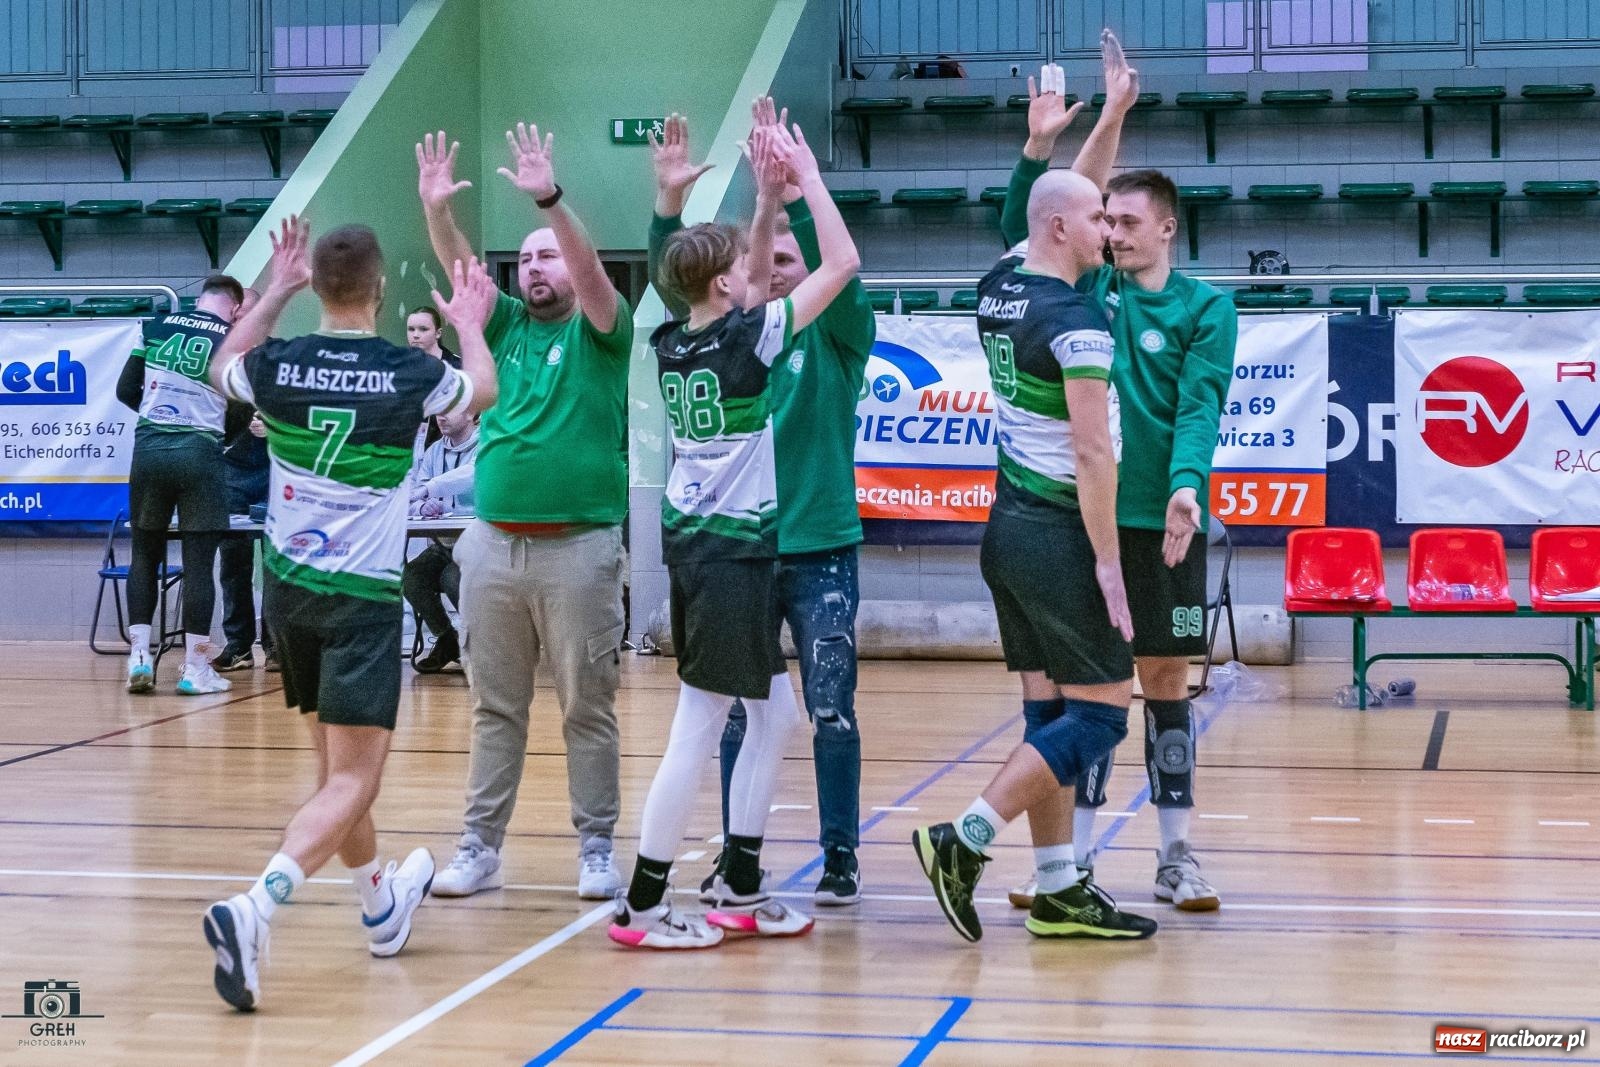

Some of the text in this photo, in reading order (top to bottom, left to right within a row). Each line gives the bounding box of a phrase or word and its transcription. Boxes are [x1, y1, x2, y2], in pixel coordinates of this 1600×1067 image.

[162, 315, 229, 335] MARCHWIAK
[156, 333, 213, 377] 49
[0, 350, 86, 402] ech
[276, 362, 397, 393] BŁASZCZOK
[1235, 364, 1295, 380] orzu:
[661, 368, 725, 440] 98
[918, 389, 994, 414] MUL
[1248, 396, 1276, 415] 69
[1417, 390, 1527, 434] RV
[0, 421, 126, 438] 95, 606 363 647
[308, 405, 356, 478] 7
[1282, 428, 1295, 447] 3
[4, 443, 116, 459] Eichendorffa 2
[1218, 482, 1309, 516] 55 77
[1172, 605, 1203, 637] 99
